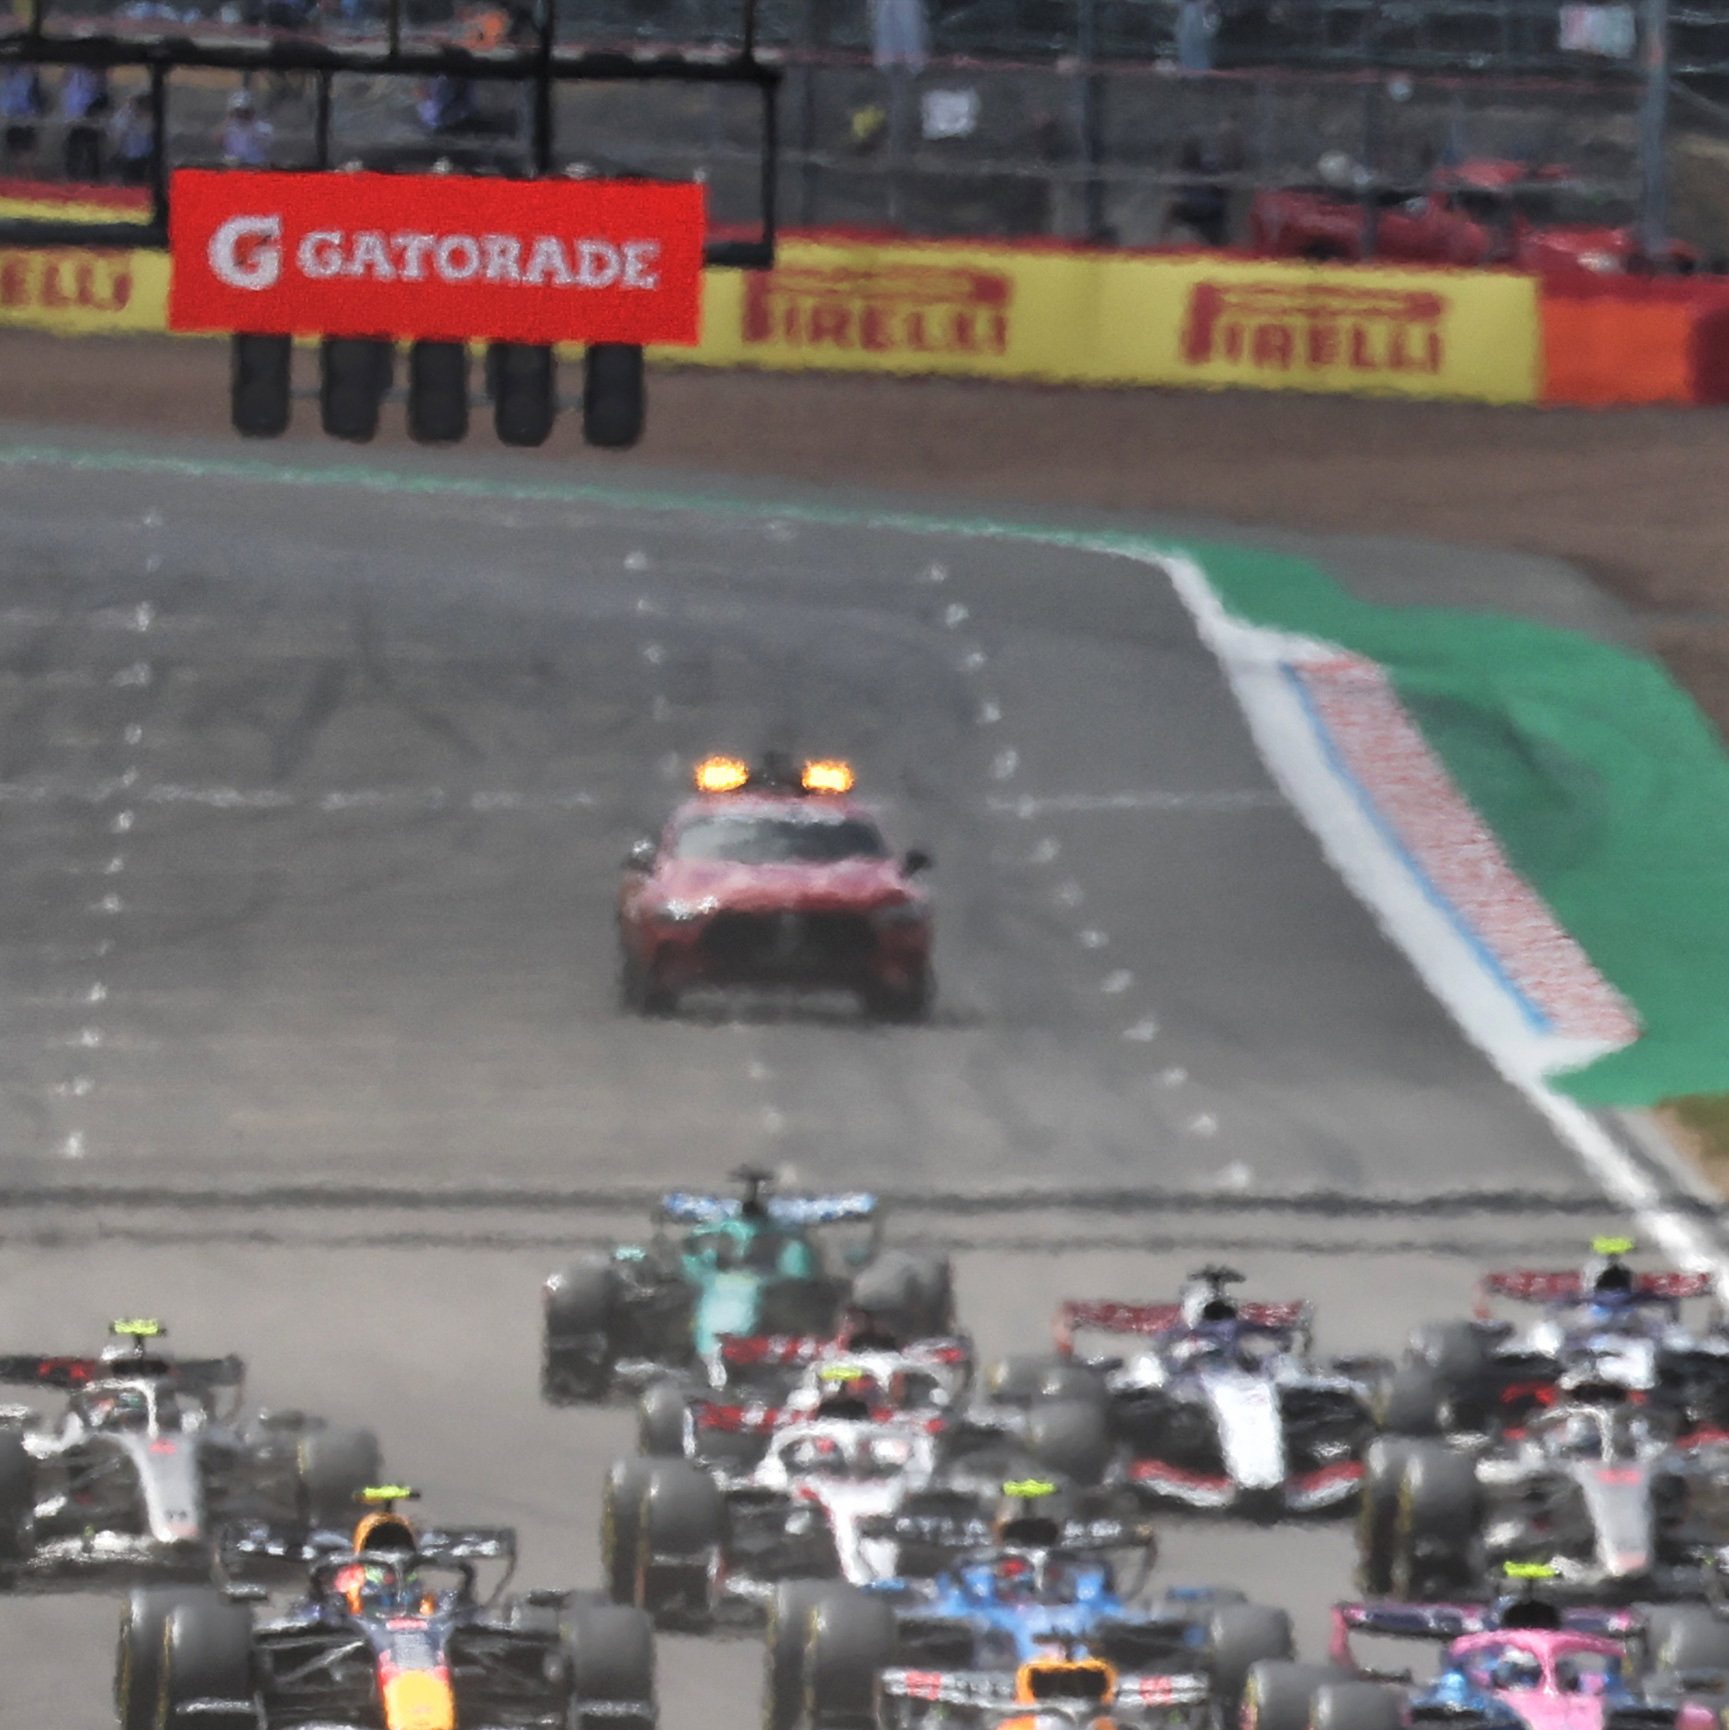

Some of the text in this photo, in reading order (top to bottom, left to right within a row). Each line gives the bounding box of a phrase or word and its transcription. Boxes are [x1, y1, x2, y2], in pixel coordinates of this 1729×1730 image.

[297, 231, 662, 290] GATORADE
[742, 262, 1014, 354] PIRELLI
[1180, 280, 1446, 374] PIRELLI
